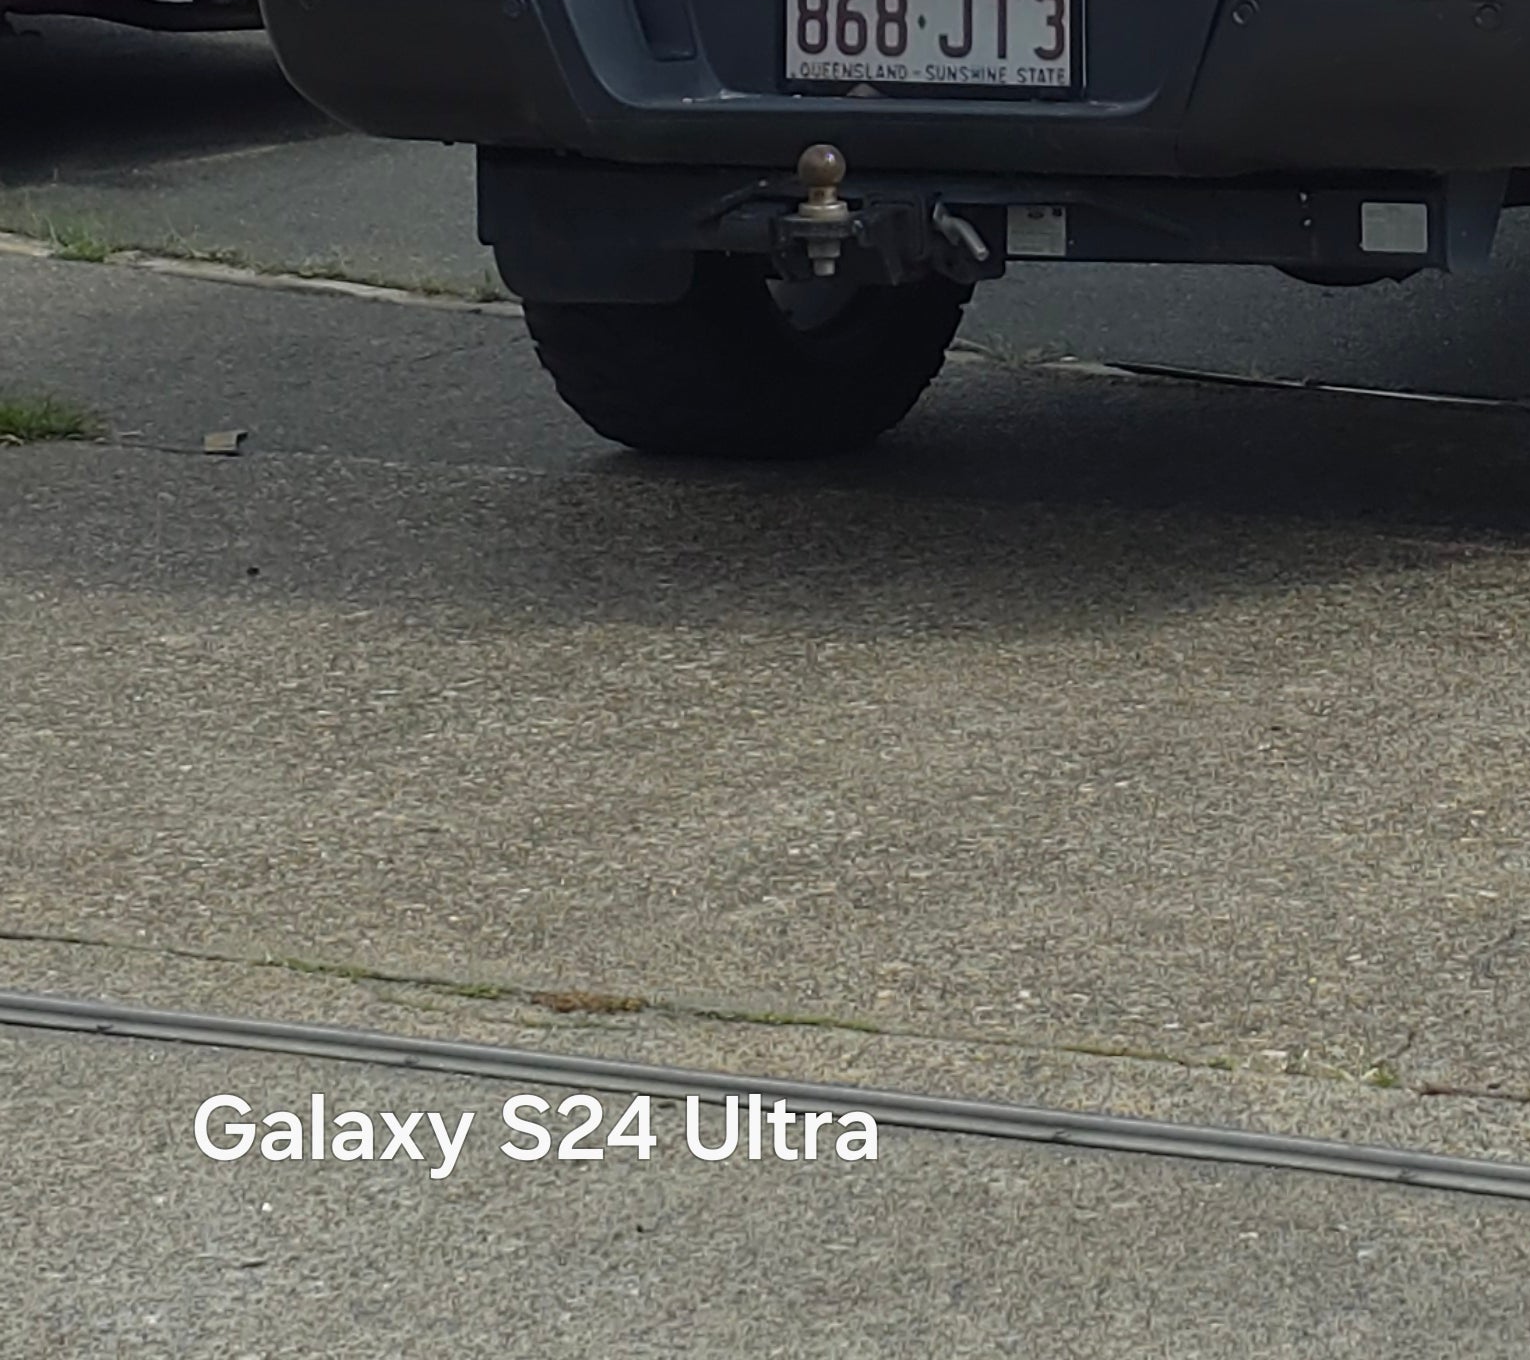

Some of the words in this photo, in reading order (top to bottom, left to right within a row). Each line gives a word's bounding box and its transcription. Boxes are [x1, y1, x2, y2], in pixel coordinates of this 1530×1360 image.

[799, 62, 908, 80] QUEENSLAND
[924, 64, 1008, 83] SUNSHINE
[1016, 68, 1067, 84] STATE
